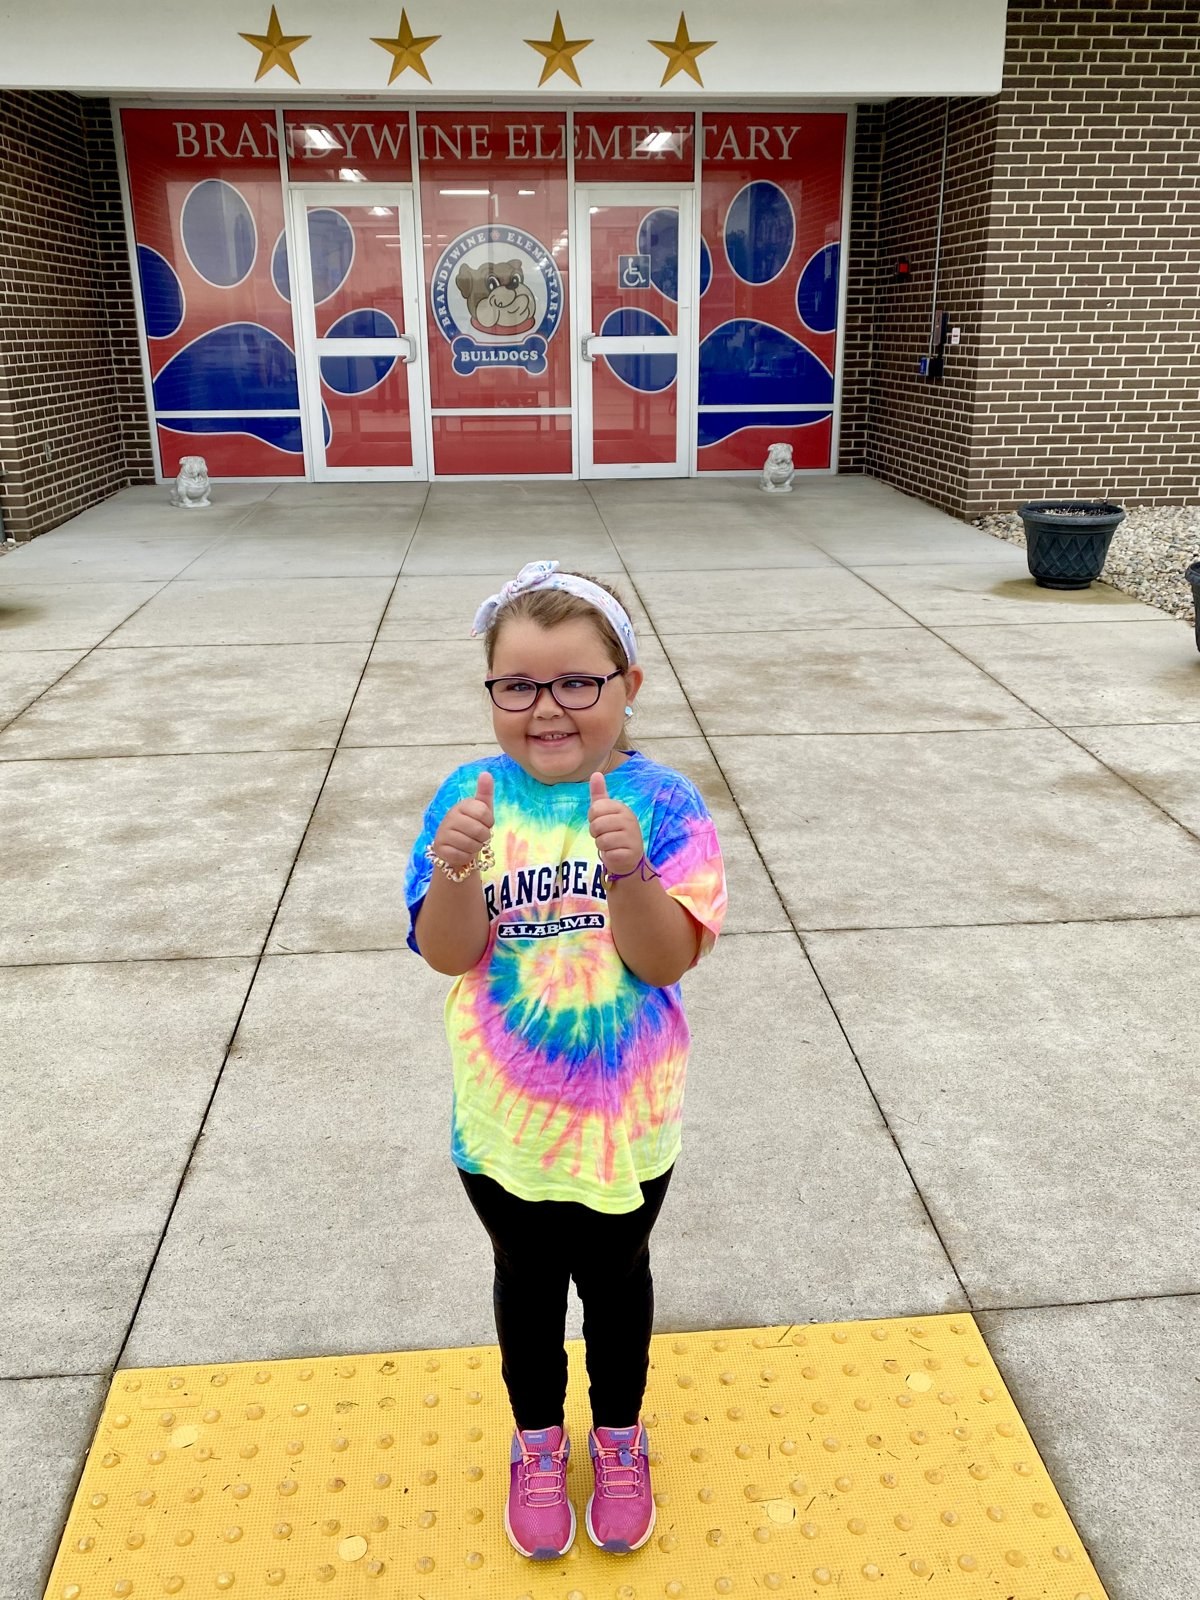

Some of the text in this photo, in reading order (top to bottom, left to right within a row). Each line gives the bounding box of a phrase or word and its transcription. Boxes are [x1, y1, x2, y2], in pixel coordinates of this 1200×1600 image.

[172, 122, 493, 160] BRANDYWINE
[437, 232, 486, 327] BRANDYWINE
[460, 350, 539, 362] BULLDOGS
[561, 860, 607, 900] BEA
[500, 915, 602, 936] ALABMA
